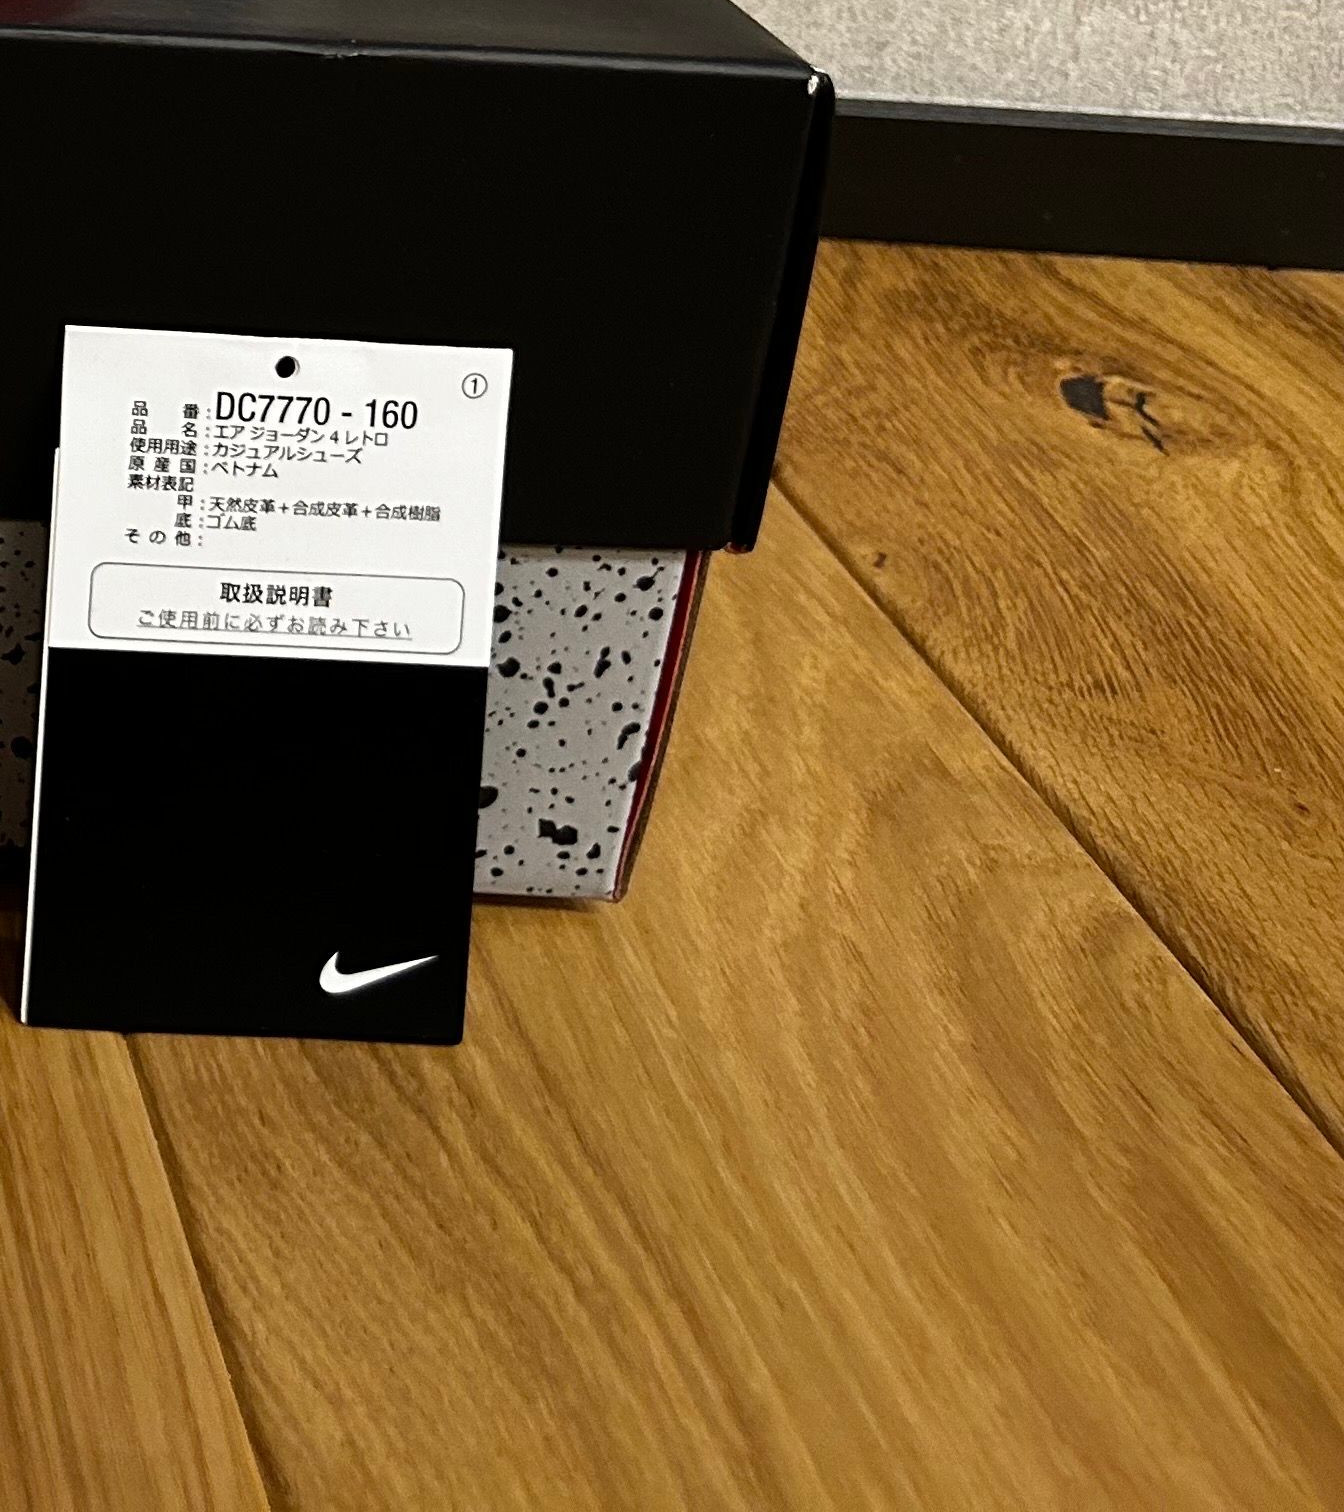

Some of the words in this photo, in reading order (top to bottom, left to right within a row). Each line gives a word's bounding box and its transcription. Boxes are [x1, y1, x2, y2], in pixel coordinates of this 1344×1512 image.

[215, 391, 331, 426] DC7770
[365, 399, 418, 430] 160
[219, 582, 333, 608] 取扱説明書
[137, 609, 411, 638] ご使用前に必ずお読み下さい
